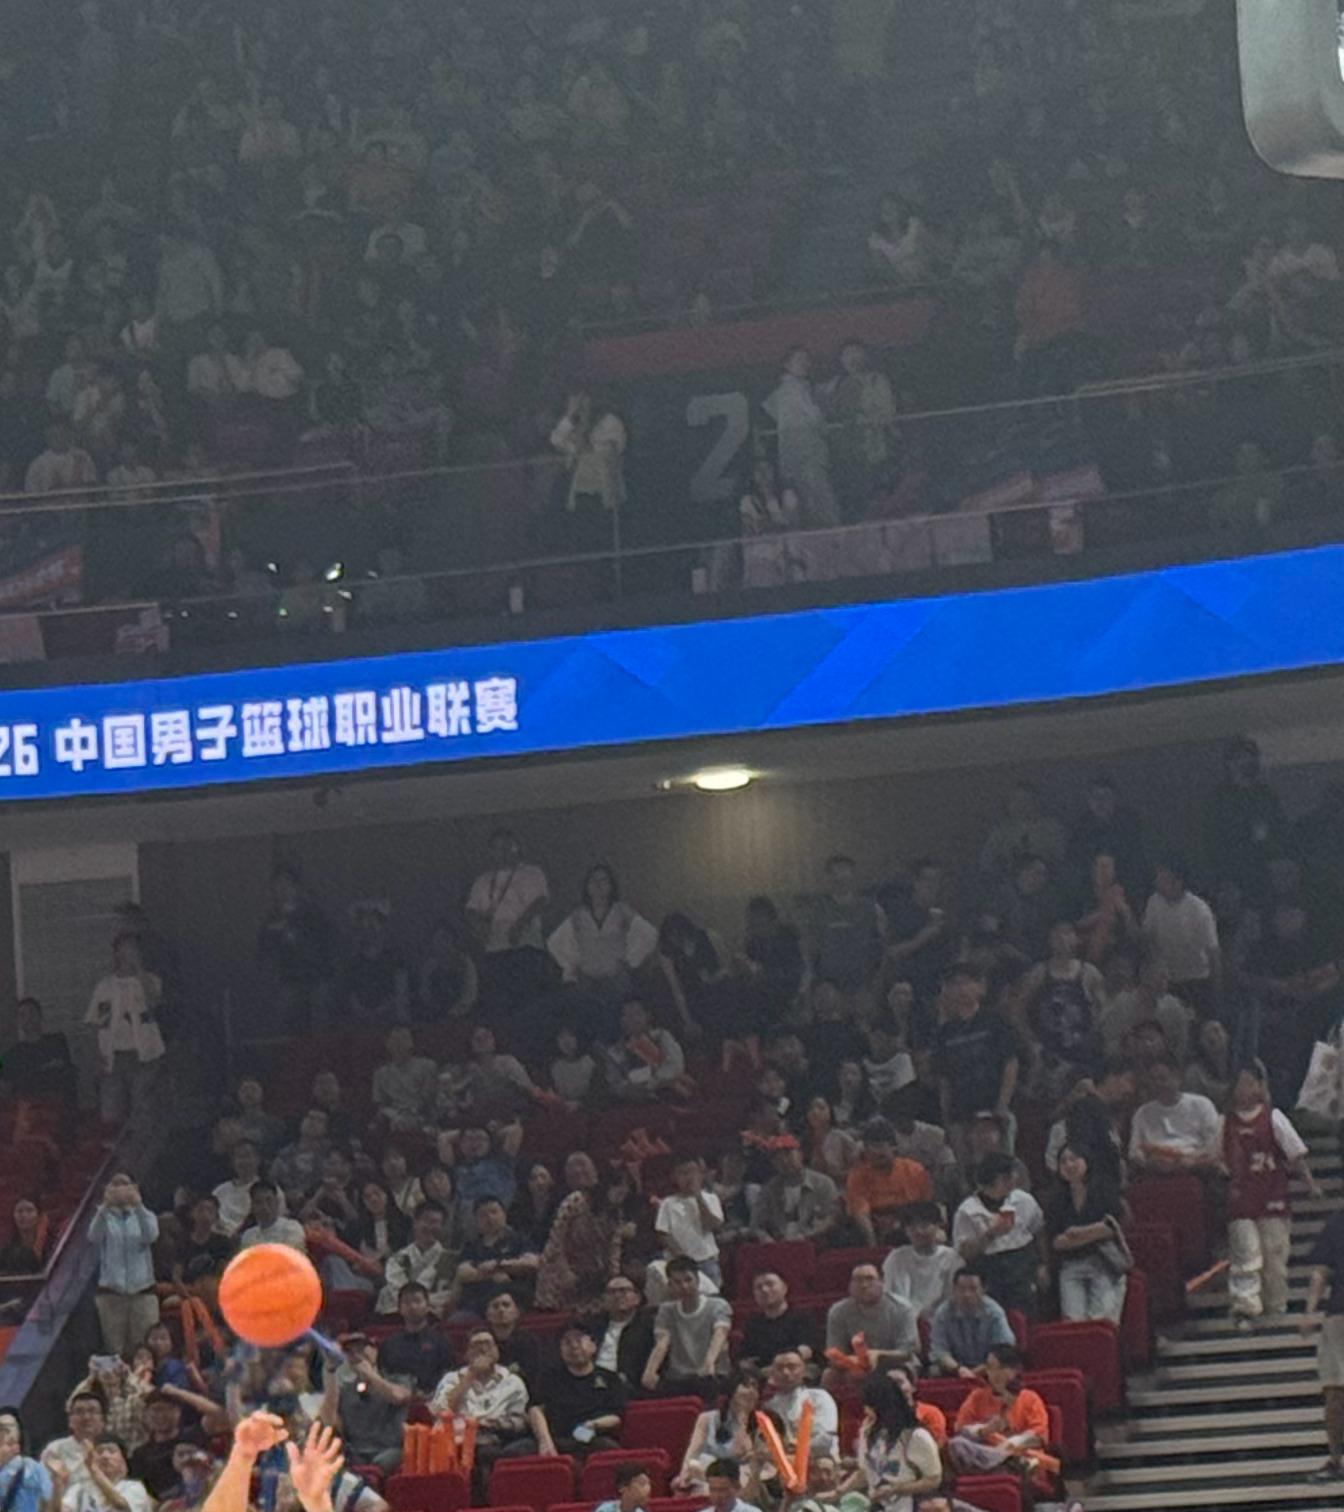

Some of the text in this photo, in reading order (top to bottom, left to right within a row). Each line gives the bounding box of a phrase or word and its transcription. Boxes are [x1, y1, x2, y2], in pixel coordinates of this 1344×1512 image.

[55, 677, 518, 773] 中国男子篮球职业联赛
